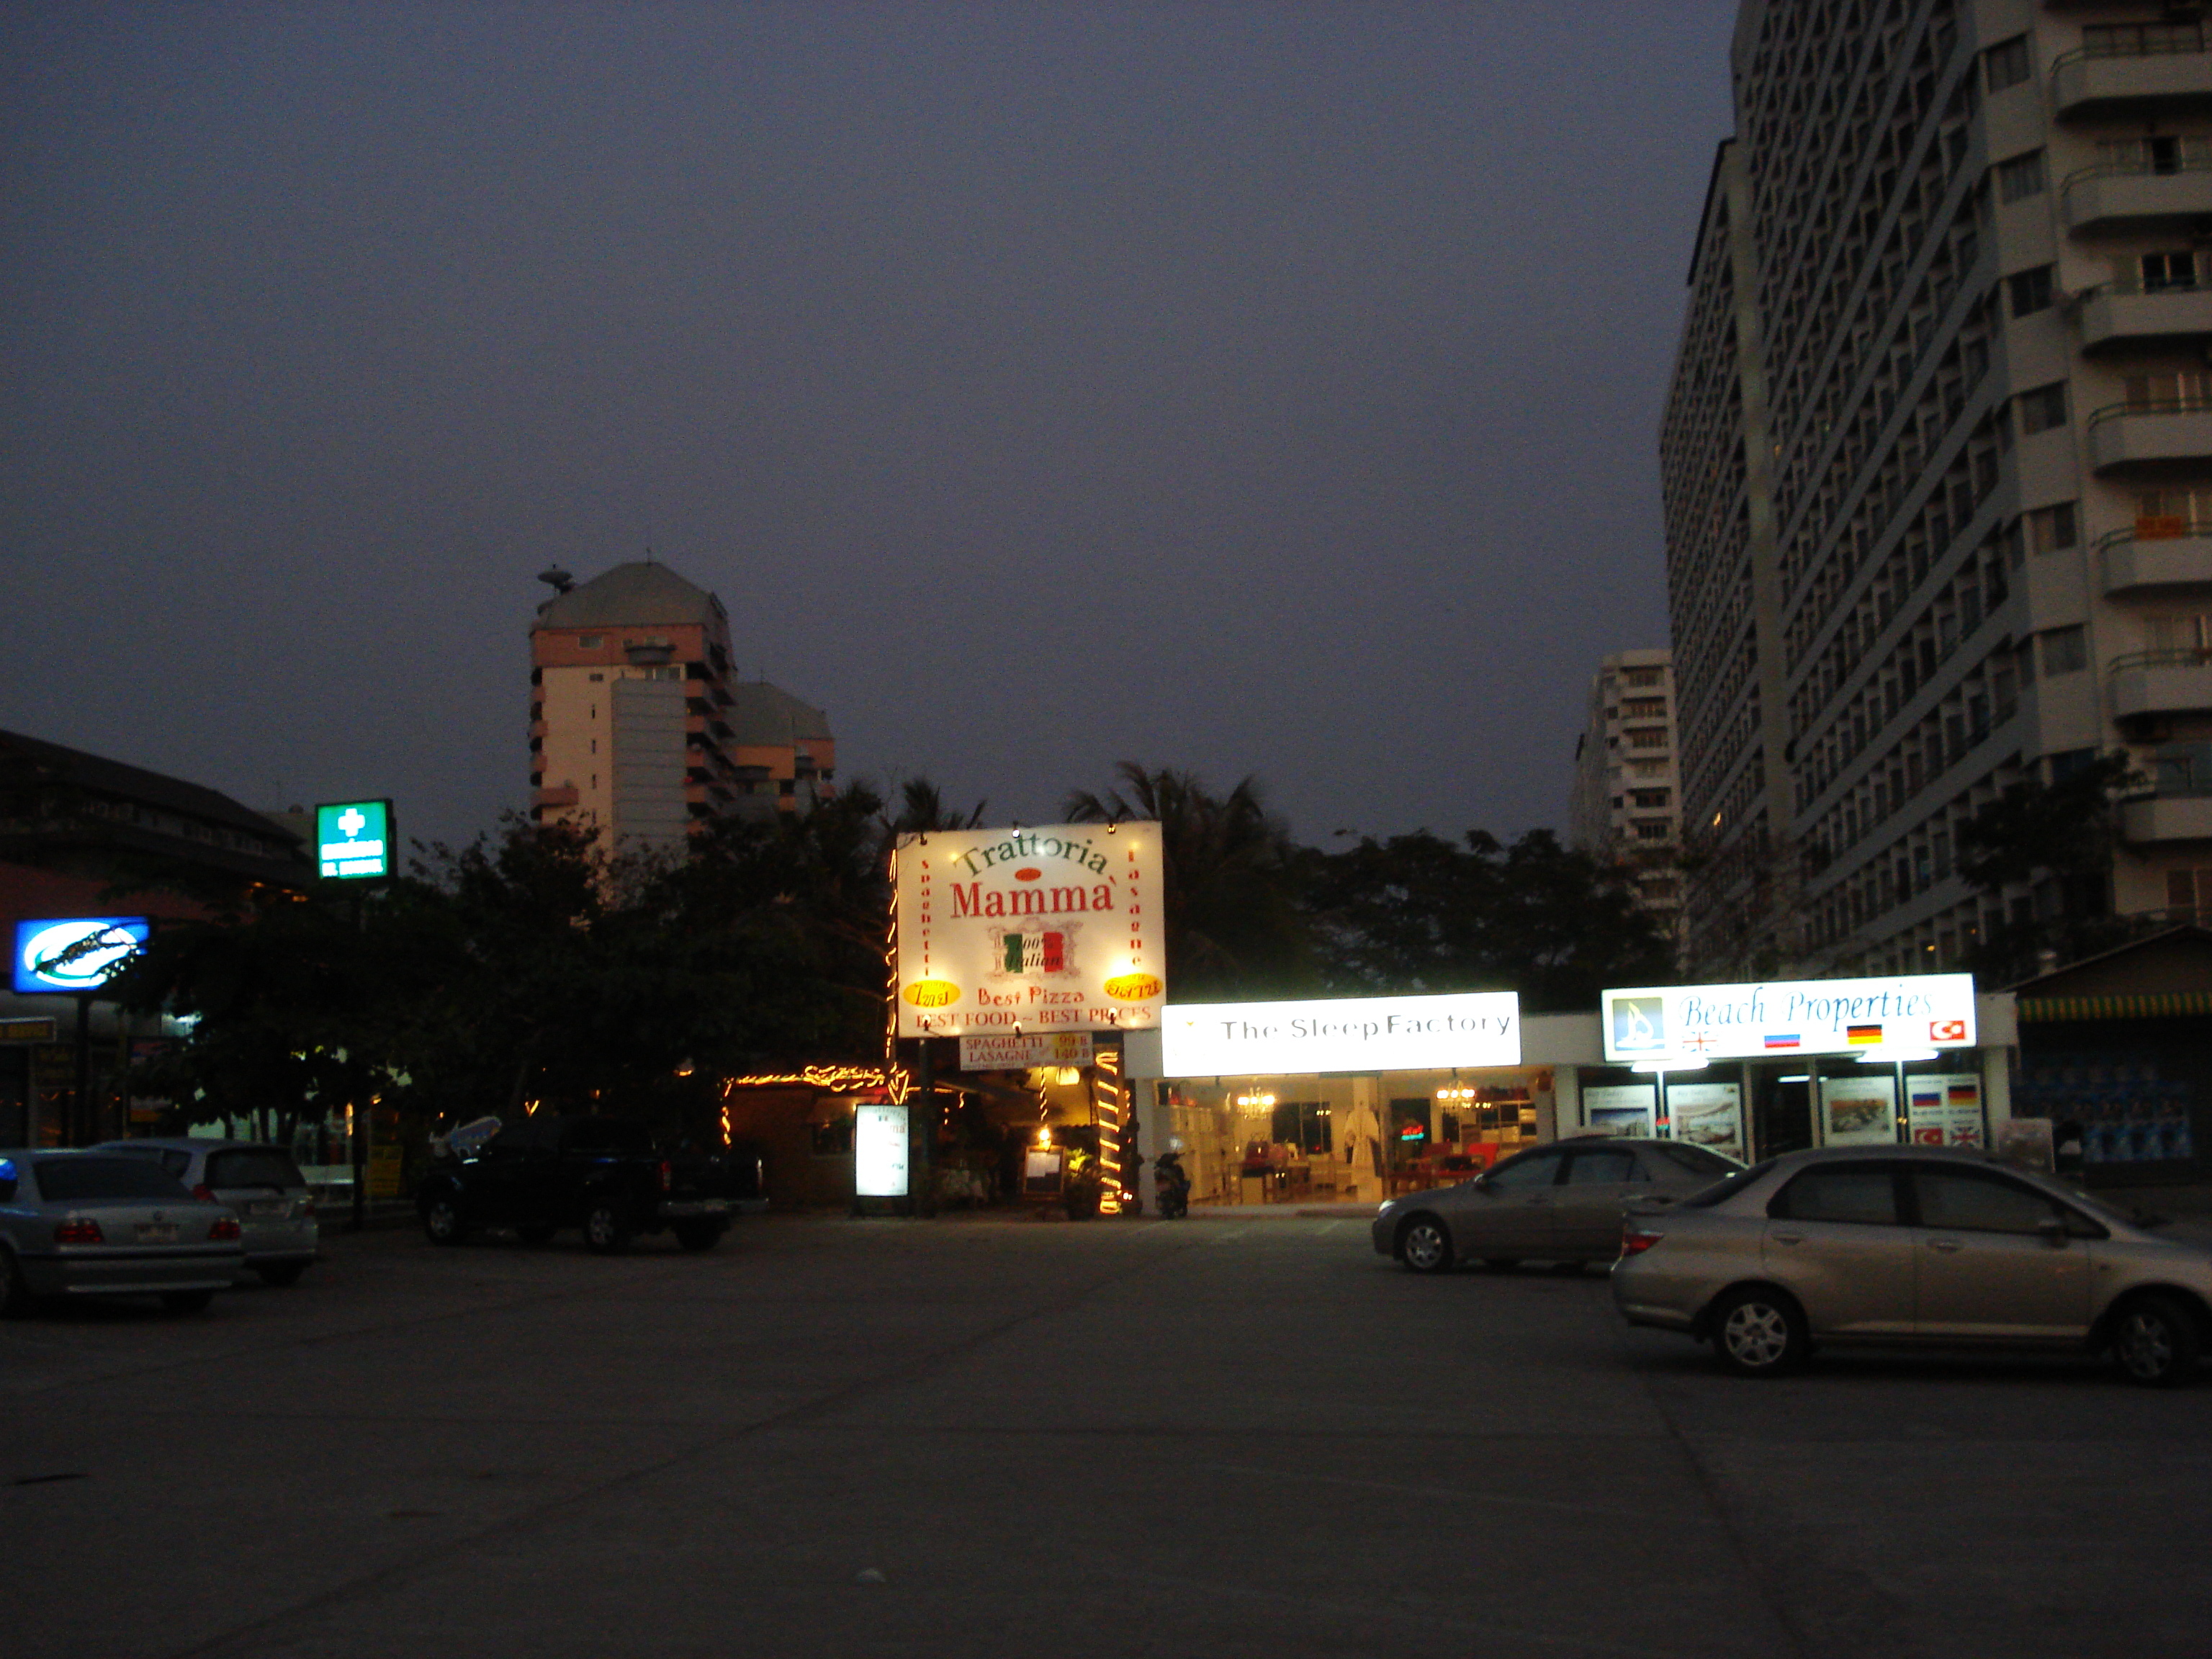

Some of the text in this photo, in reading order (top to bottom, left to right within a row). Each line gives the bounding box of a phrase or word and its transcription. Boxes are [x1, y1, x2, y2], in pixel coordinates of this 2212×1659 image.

[953, 832, 1109, 877] Trattoria
[1008, 953, 1061, 968] Italian
[914, 984, 948, 1007] ไทย
[978, 985, 1085, 1006] Best Pizza
[965, 1011, 1017, 1028] FOOD
[1039, 1008, 1082, 1025] BEST
[1678, 984, 1934, 1033] Beach Properties
[1220, 1020, 1278, 1040] The
[966, 1035, 1044, 1051] SPAGHETTI
